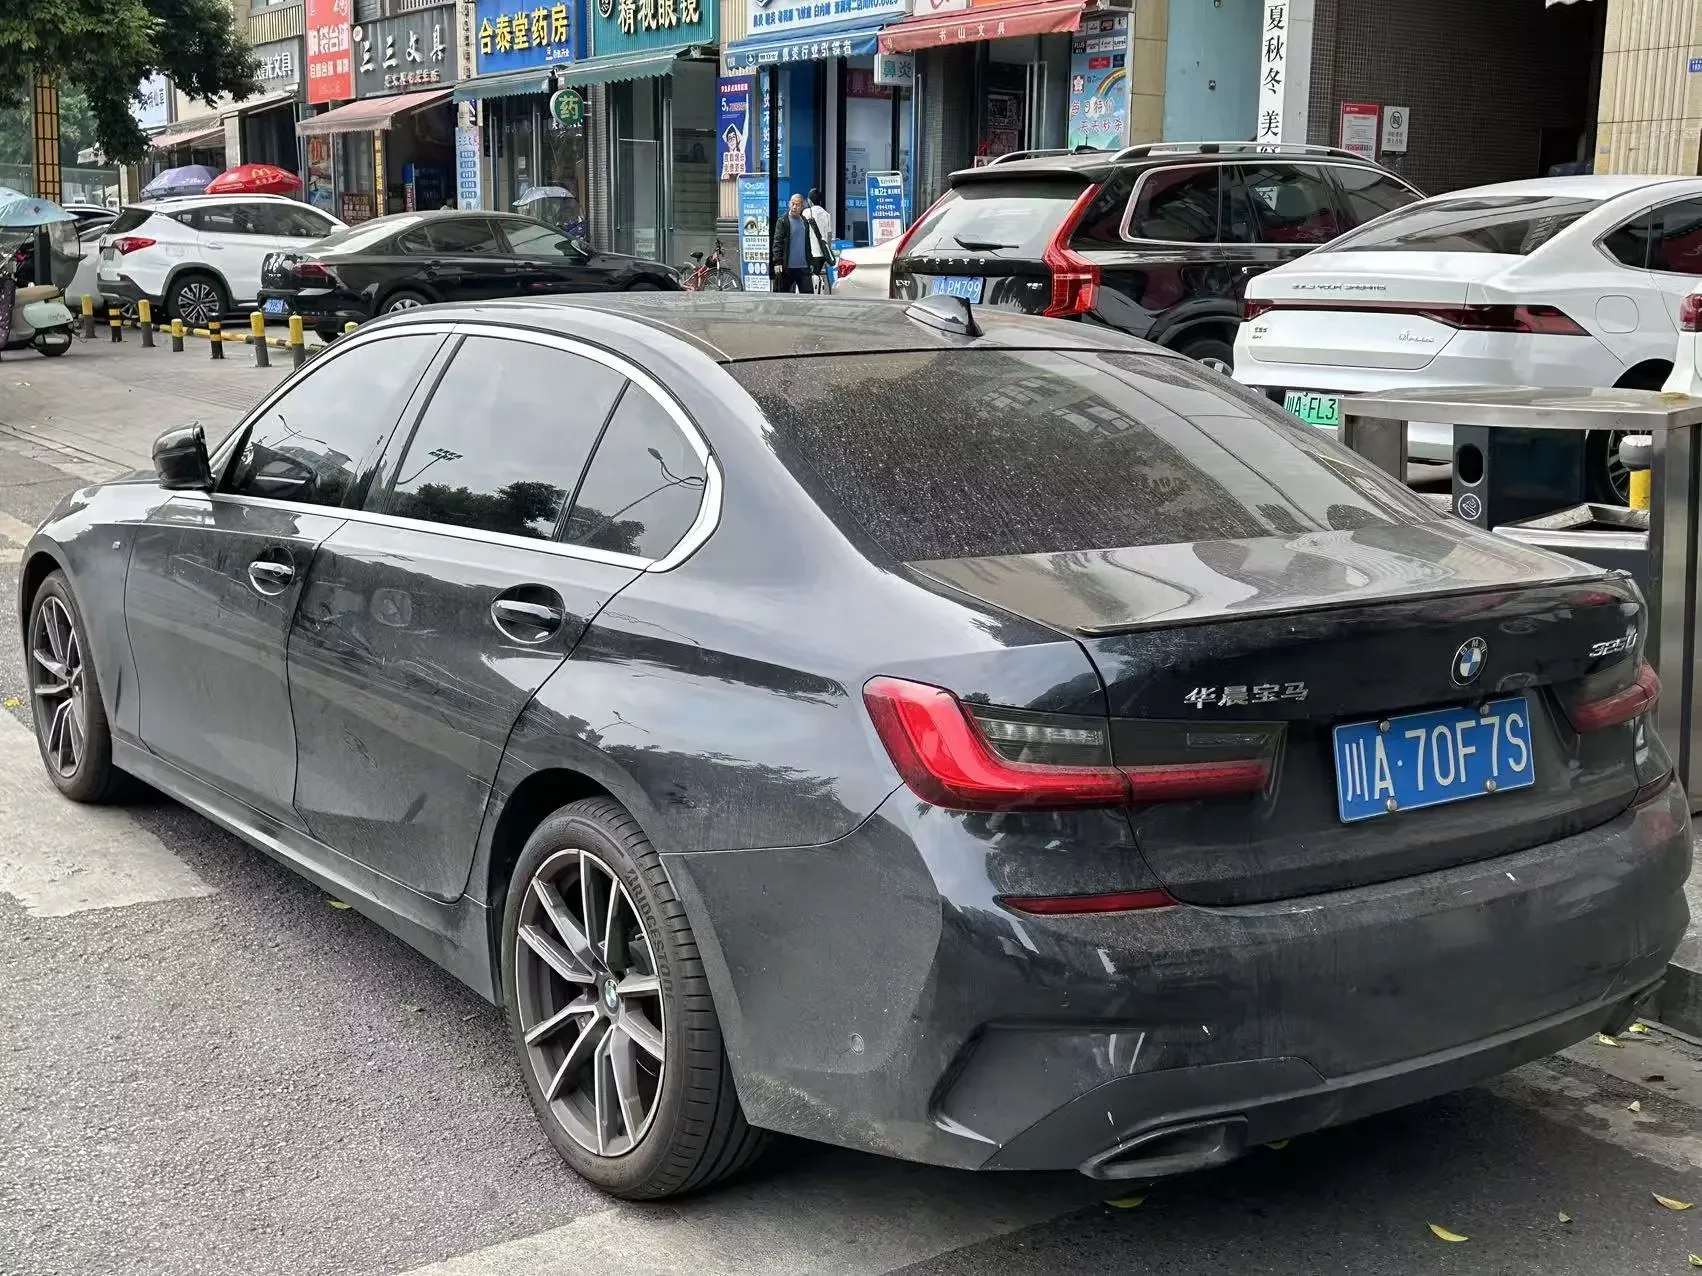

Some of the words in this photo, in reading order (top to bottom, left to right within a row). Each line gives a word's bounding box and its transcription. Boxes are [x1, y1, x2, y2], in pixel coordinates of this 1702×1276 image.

[480, 2, 569, 54] 合泰堂药房
[938, 22, 1006, 42] 书山文具
[360, 24, 447, 73] 三三文具
[782, 40, 852, 62] 鼻炎行业引领者
[1263, 3, 1286, 94] 夏秋冬
[884, 60, 912, 78] 鼻炎
[558, 95, 579, 119] 药
[1080, 119, 1124, 134] 天天秒杀
[1460, 639, 1487, 656] BMW
[1184, 682, 1309, 709] 华晨宝马
